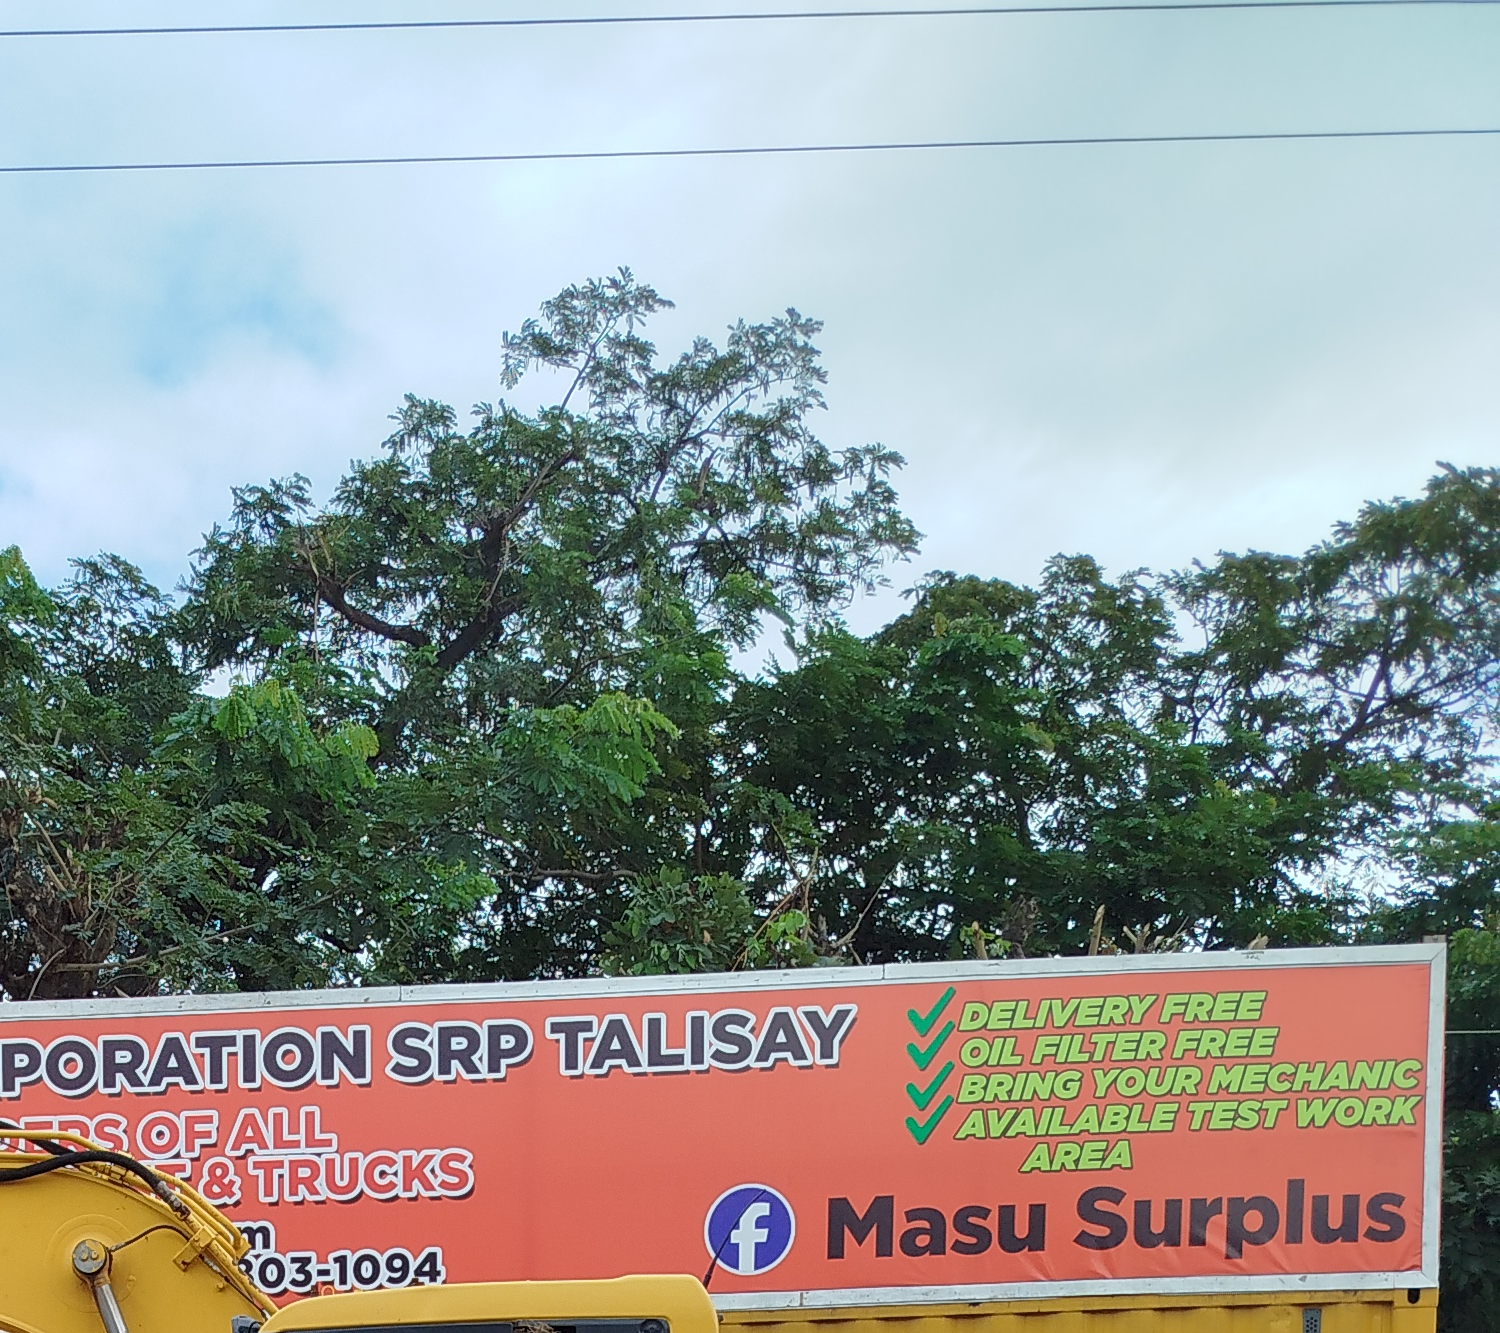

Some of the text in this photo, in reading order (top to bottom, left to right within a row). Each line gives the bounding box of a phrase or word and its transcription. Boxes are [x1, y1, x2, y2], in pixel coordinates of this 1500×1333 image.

[958, 991, 1267, 1032] DELIVERY FREE
[389, 1016, 533, 1085] SRP
[546, 1003, 857, 1077] TALISAY
[959, 1027, 1279, 1068] OIL FILTER FREE
[957, 1060, 1422, 1105] BRING YOUR MECHANIC
[136, 1110, 218, 1159] OF
[228, 1106, 338, 1157] ALL
[954, 1095, 1422, 1140] AVAILABLE TEST WORK
[199, 1157, 244, 1204] &
[249, 1149, 474, 1204] TRUCKS
[1019, 1140, 1132, 1174] AREA
[827, 1195, 1046, 1260] Masu
[1073, 1179, 1406, 1260] Surplus
